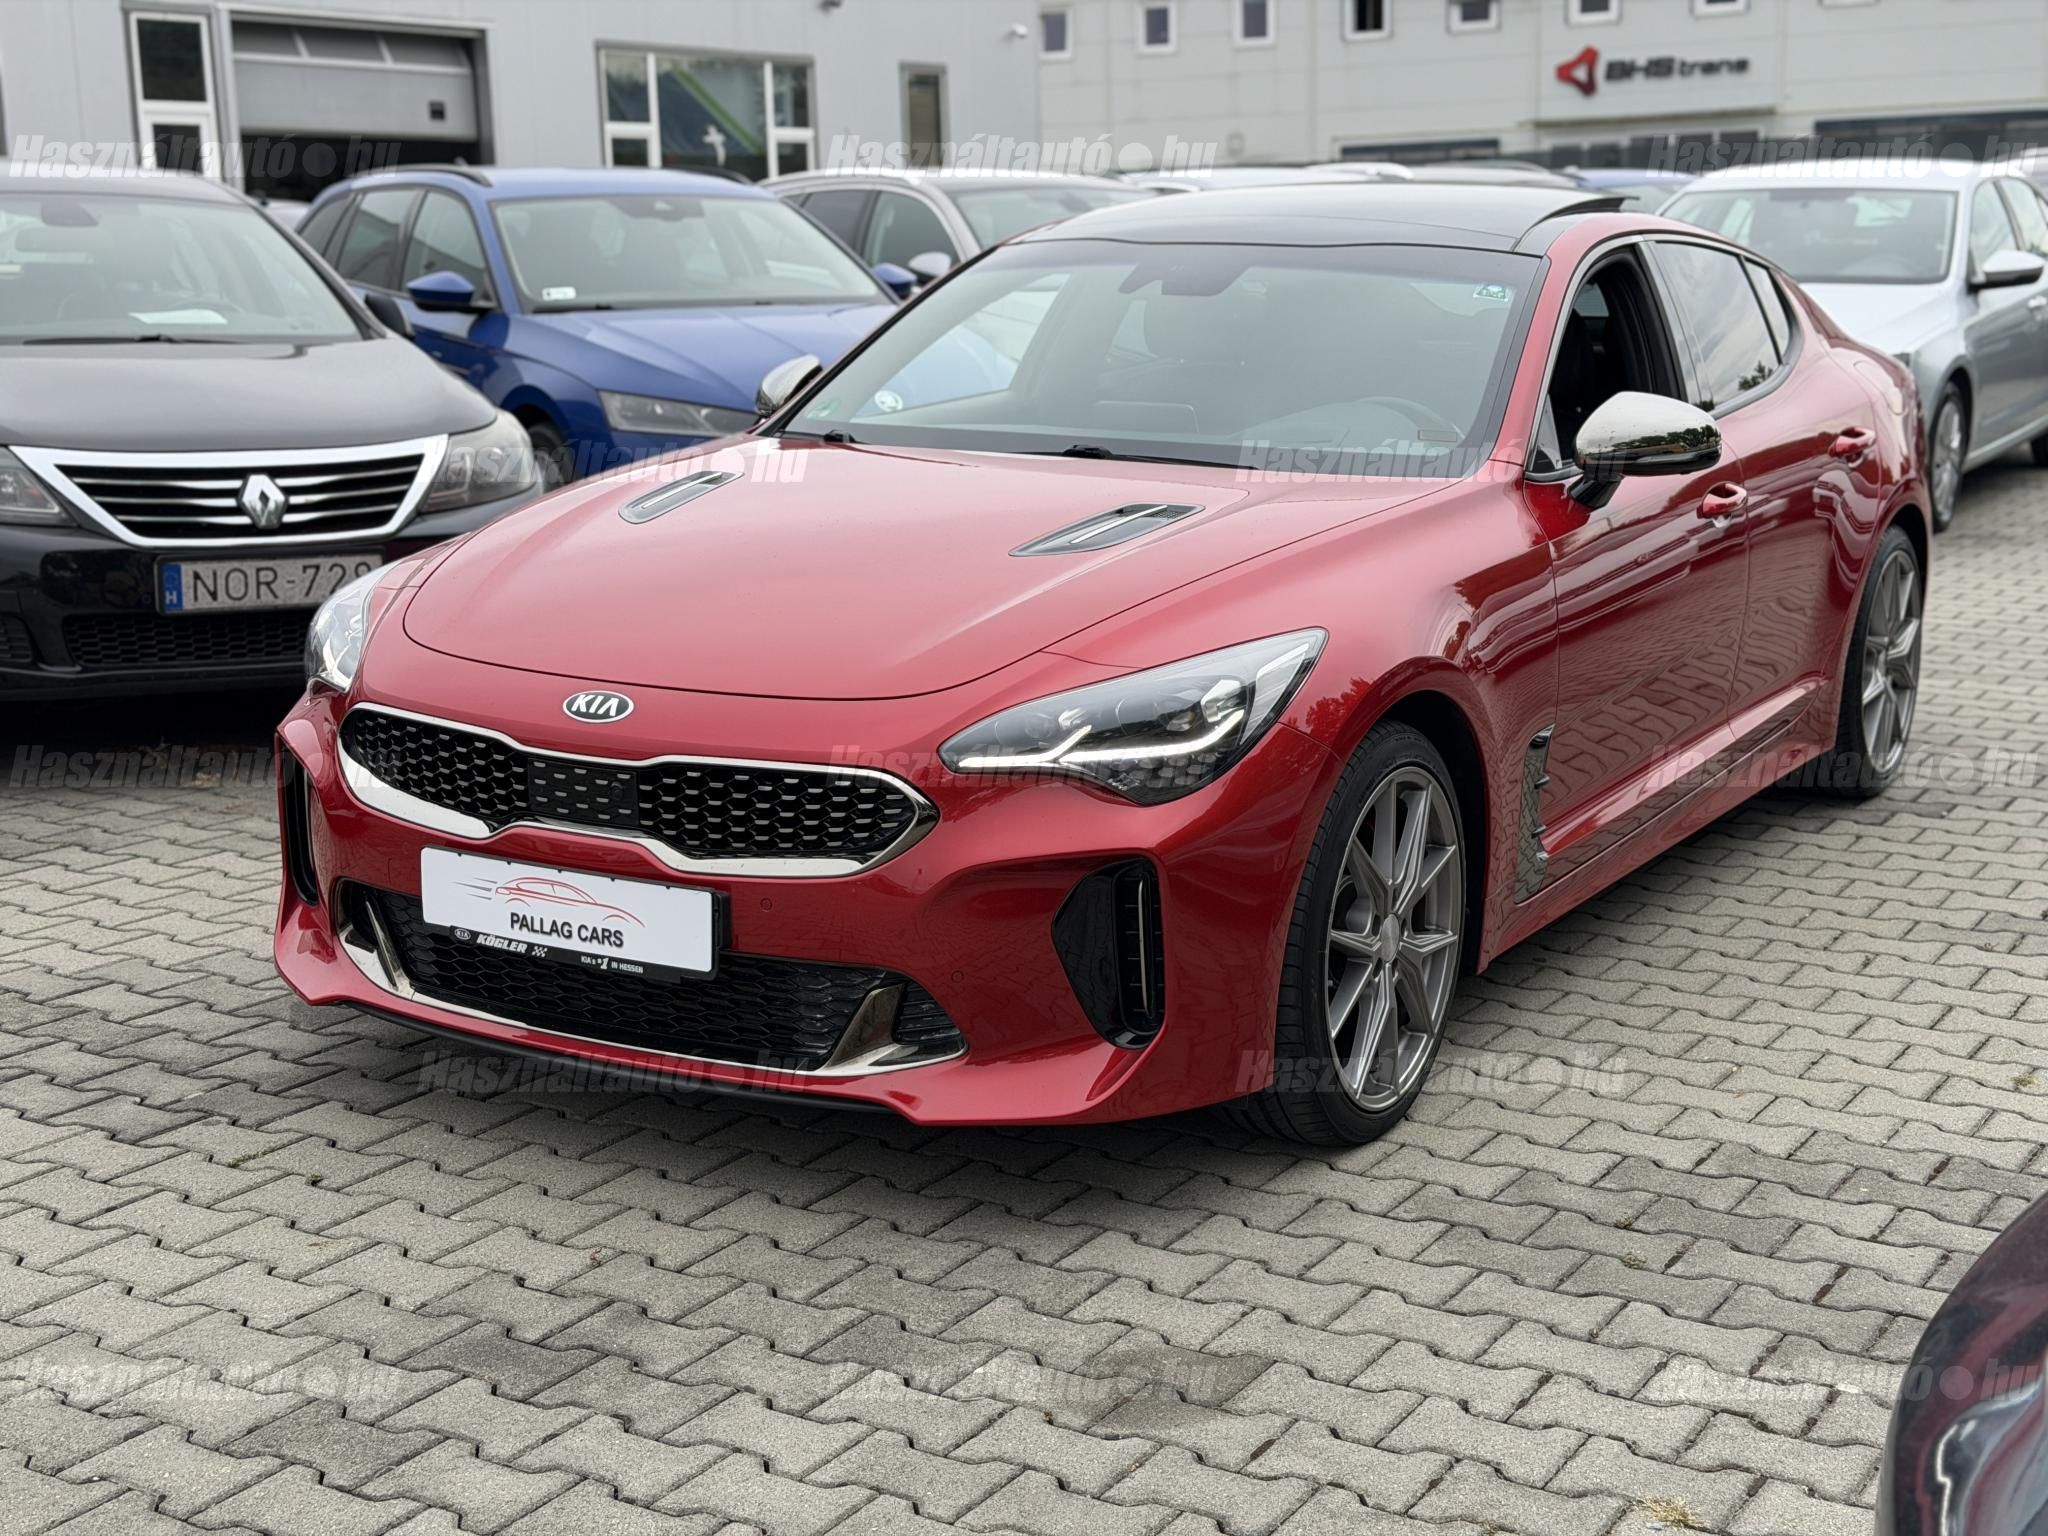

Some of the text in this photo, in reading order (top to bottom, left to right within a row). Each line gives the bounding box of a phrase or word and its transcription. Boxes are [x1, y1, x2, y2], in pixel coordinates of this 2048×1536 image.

[571, 693, 620, 717] KIA
[510, 911, 625, 948] PALLAG CARS
[476, 933, 528, 954] KÖGLER
[619, 962, 644, 974] HESSEN
